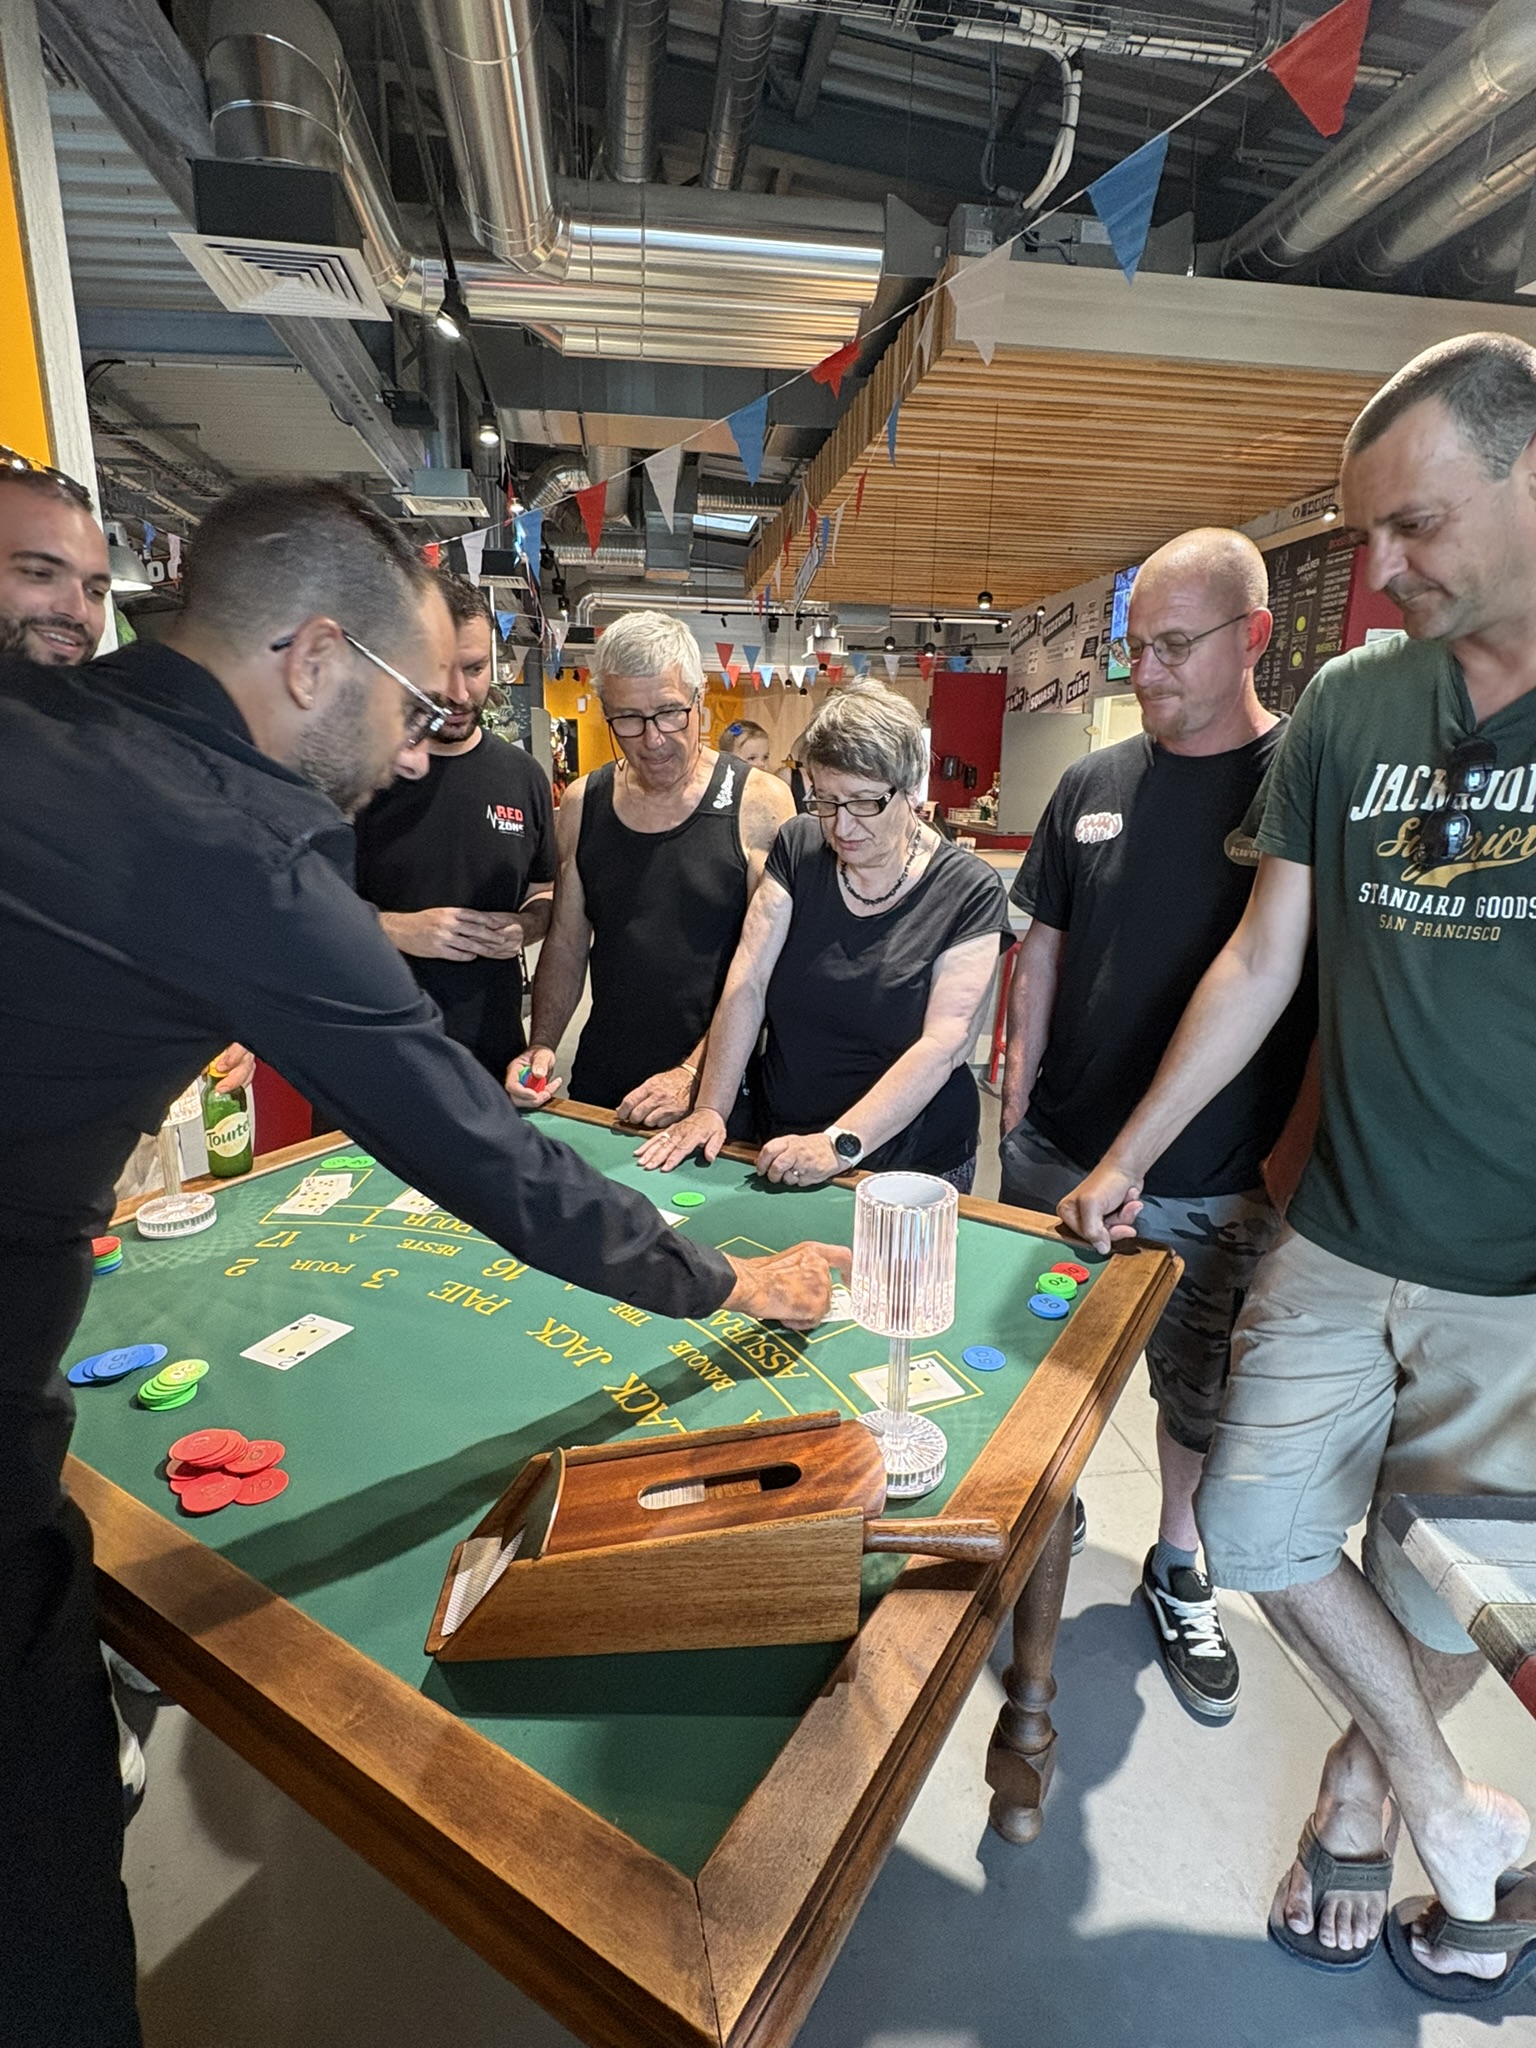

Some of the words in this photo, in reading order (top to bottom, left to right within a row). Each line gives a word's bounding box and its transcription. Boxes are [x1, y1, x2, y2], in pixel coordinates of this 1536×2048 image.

[1030, 682, 1057, 710] SQUASH
[1068, 676, 1089, 700] CUBE
[496, 804, 524, 822] RED
[498, 820, 525, 832] ZONE
[1358, 882, 1466, 918] STANDARD
[1380, 914, 1407, 931] SAN
[1412, 921, 1501, 942] FRANCISCO
[206, 1119, 250, 1148] Tourte
[362, 1209, 385, 1226] 1
[403, 1213, 473, 1233] POUR
[255, 1231, 302, 1247] 17
[349, 1233, 367, 1243] A
[396, 1238, 463, 1257] RESTE
[224, 1258, 259, 1277] 2
[290, 1259, 356, 1274] POUR
[482, 1258, 530, 1281] 16
[361, 1268, 400, 1289] 3
[428, 1280, 512, 1316] PAIE
[608, 1302, 652, 1327] TIRE
[527, 1318, 613, 1367] JACK
[710, 1309, 810, 1380] ASSURA
[667, 1340, 737, 1392] BANQUE
